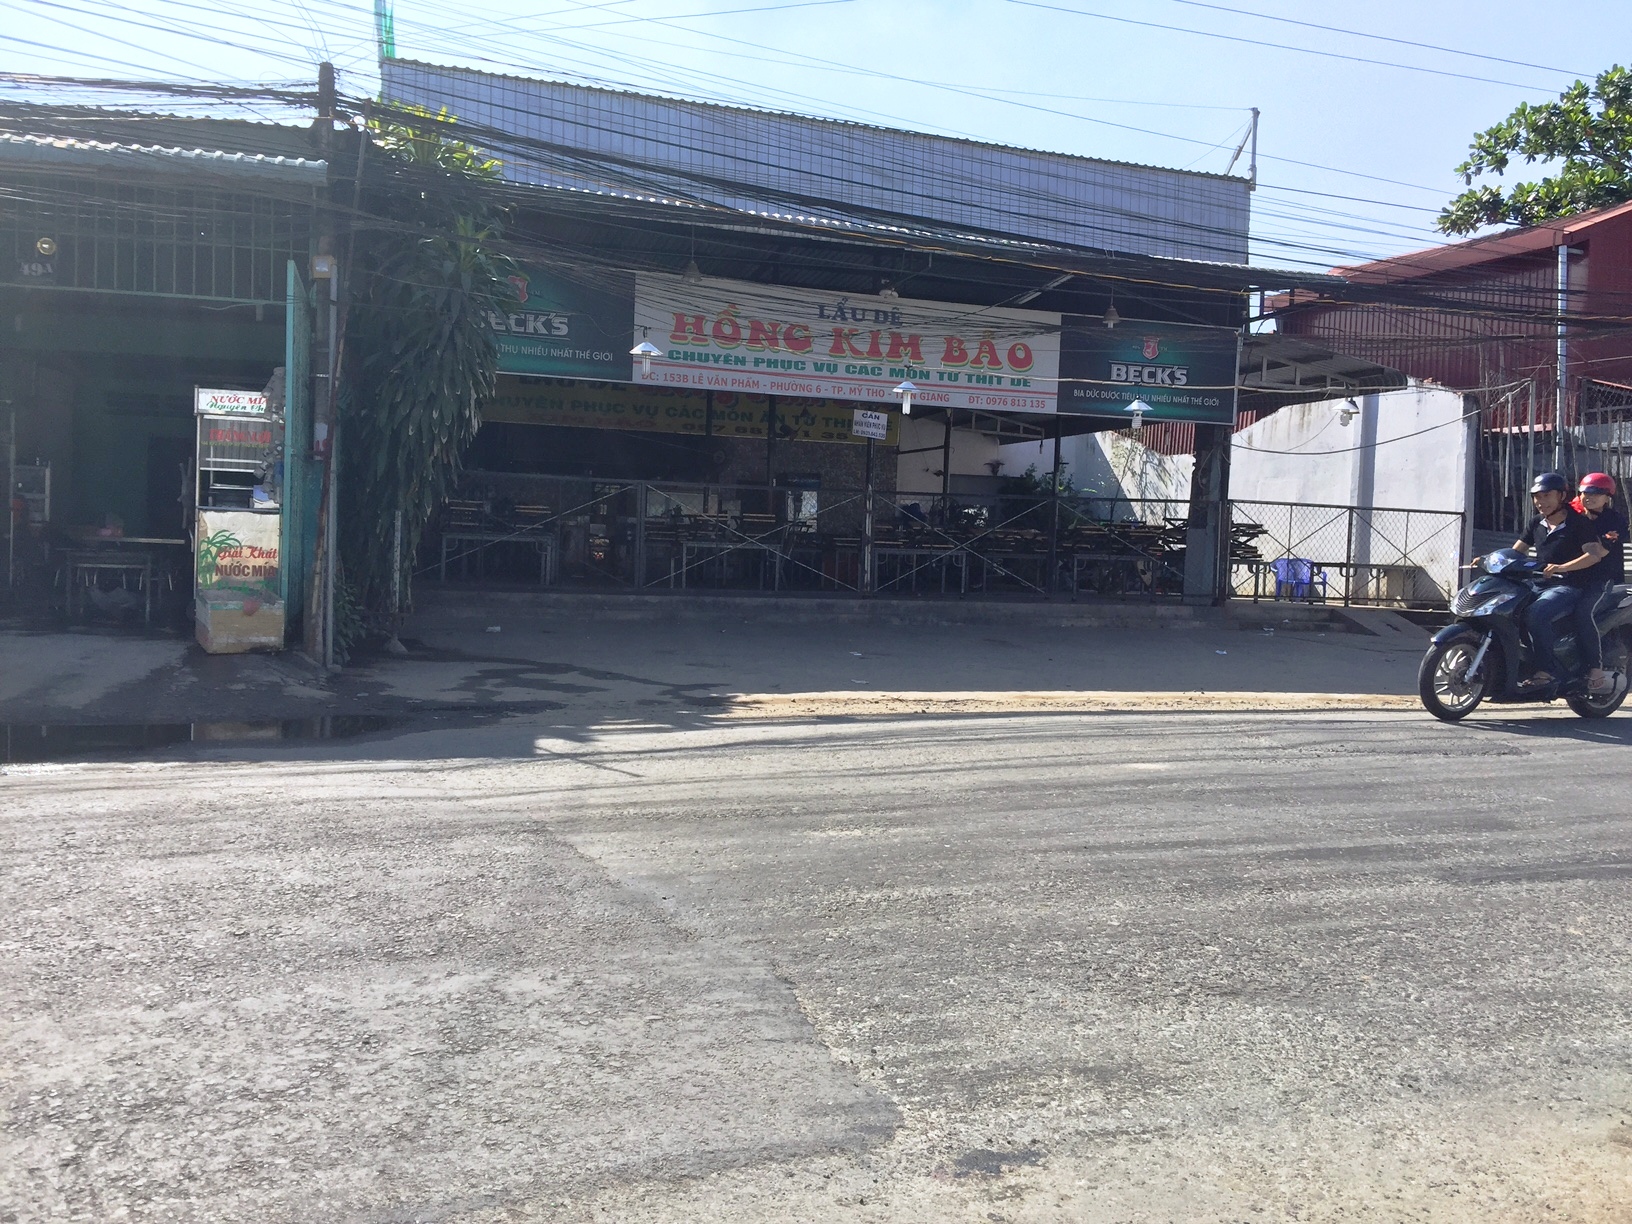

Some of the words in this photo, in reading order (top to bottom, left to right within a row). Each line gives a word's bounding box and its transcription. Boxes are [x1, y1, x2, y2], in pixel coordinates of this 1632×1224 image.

[817, 297, 866, 322] LẨU
[480, 310, 569, 336] ECK'S
[669, 304, 815, 355] HỒNG
[828, 327, 925, 364] KIM
[940, 329, 1034, 373] BẢO
[550, 347, 573, 358] NHẤT
[575, 349, 590, 360] THẾ
[668, 349, 747, 366] CHUYÊN
[753, 357, 806, 372] PHỤC
[812, 362, 839, 375] VỤ
[1110, 364, 1188, 386] BECK'S
[663, 373, 689, 384] 153B
[692, 373, 704, 384] LÊ
[707, 375, 728, 387] VĂN
[770, 382, 813, 393] PHƯỜNG
[815, 384, 822, 393] 6
[832, 386, 846, 395] TP.
[849, 384, 864, 396] MỸ
[866, 388, 886, 398] THO
[895, 391, 917, 400] TIN
[920, 392, 950, 402] GIANG
[1073, 389, 1084, 397] BIA
[1101, 390, 1120, 400] ĐƯỢC
[211, 394, 245, 404] NƯỚC
[968, 395, 983, 405] ĐT:
[986, 396, 1008, 406] 0976
[1010, 398, 1027, 407] 813
[1030, 399, 1046, 409] 135
[245, 546, 278, 559] Khát
[215, 561, 250, 577] NƯỚC
[252, 562, 276, 577] MÍA
